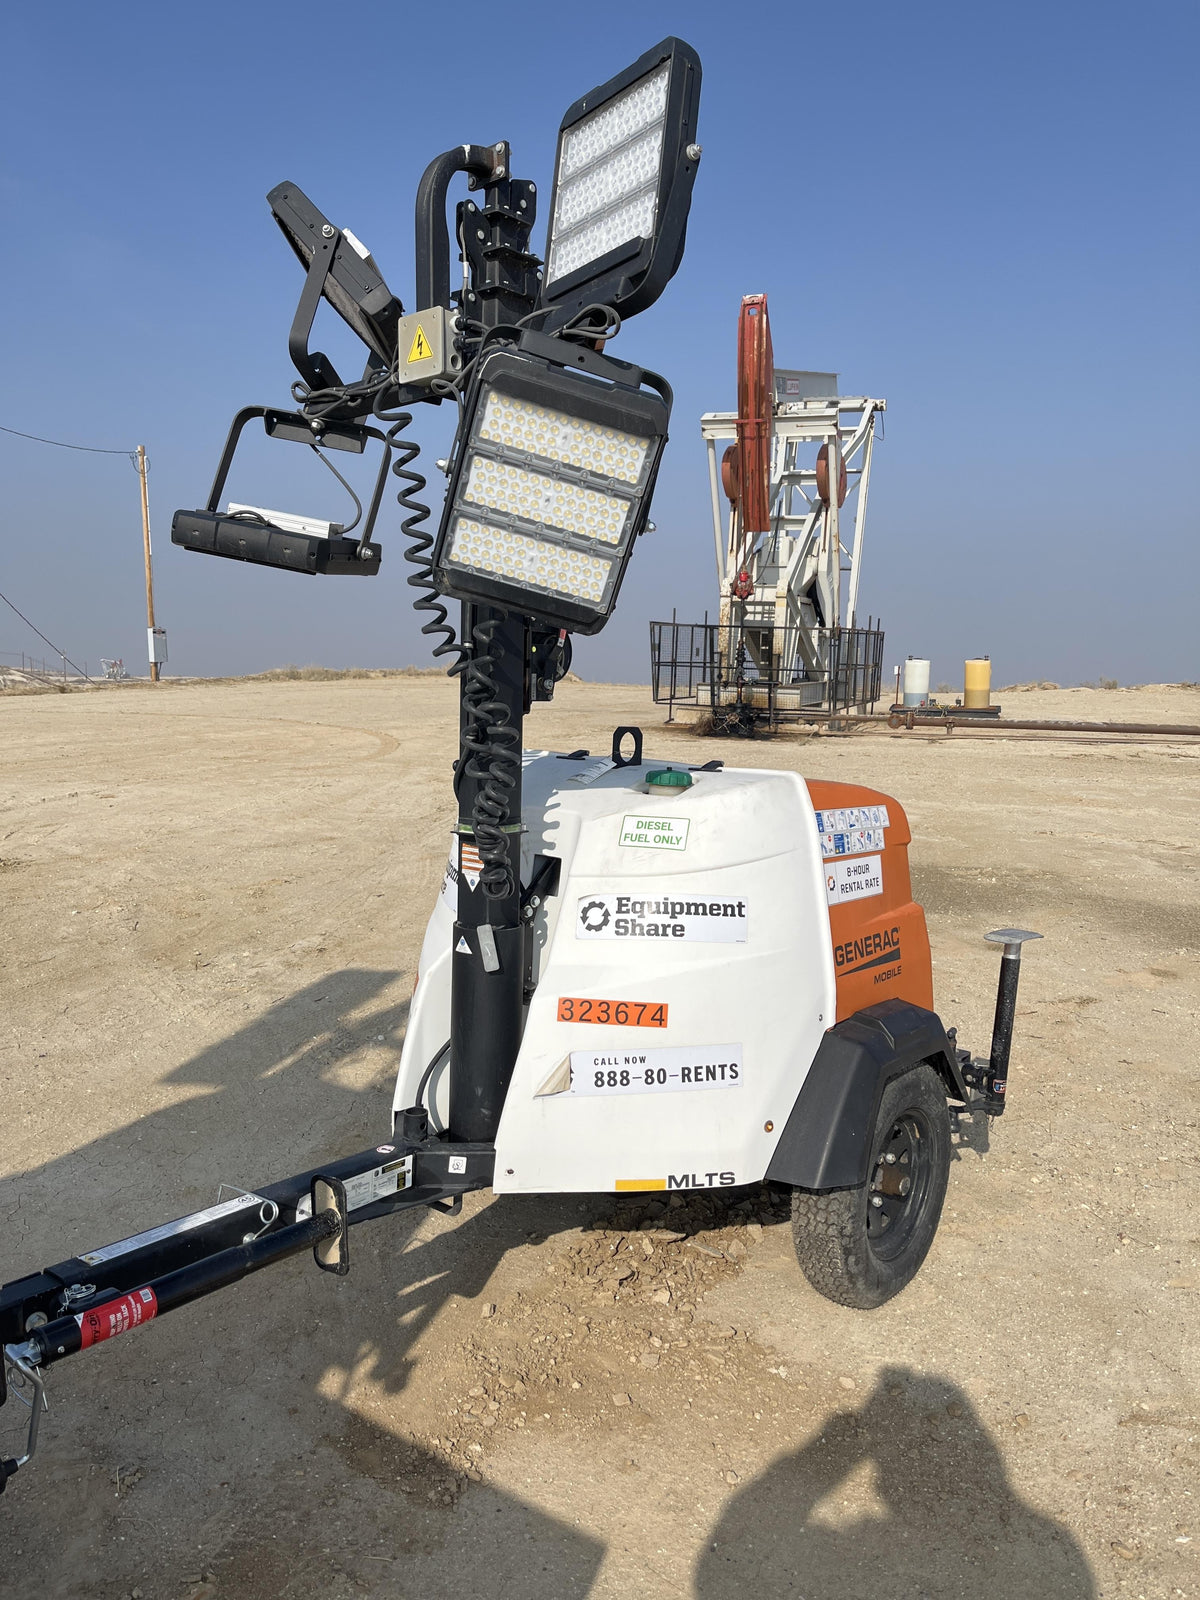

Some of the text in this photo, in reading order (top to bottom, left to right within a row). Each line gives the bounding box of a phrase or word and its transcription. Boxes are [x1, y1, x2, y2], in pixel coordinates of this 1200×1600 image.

[636, 820, 673, 831] DIESEL
[623, 833, 682, 846] FUEL ONLY
[846, 863, 870, 877] 8-HOUR
[840, 877, 880, 894] RENTAL RATE
[615, 896, 746, 919] Equipment
[614, 918, 686, 938] Share
[834, 926, 900, 967] GENERAC
[873, 965, 902, 984] MOBILE
[559, 998, 665, 1026] 323674
[593, 1055, 647, 1066] CALL NOW
[593, 1062, 739, 1088] 888-80-RENTS
[667, 1171, 736, 1189] MLTS
